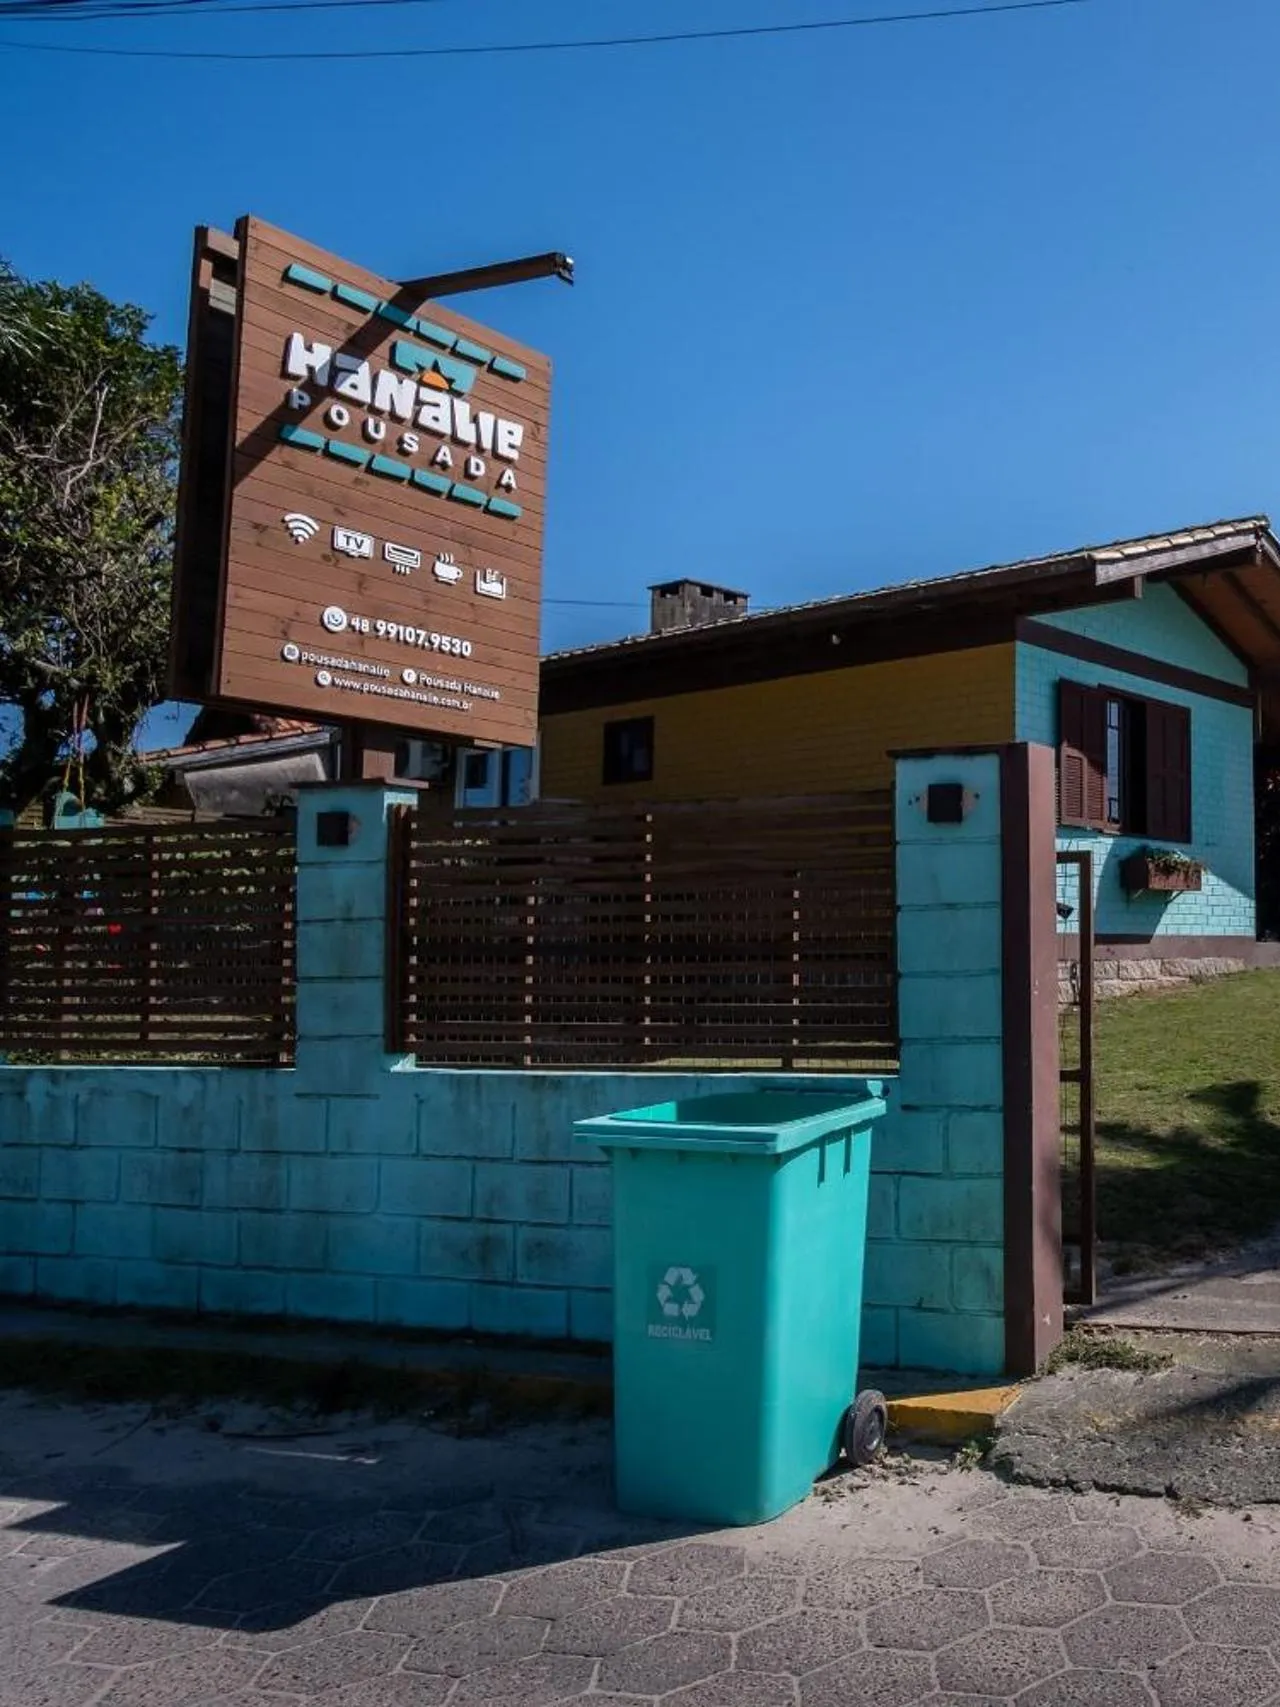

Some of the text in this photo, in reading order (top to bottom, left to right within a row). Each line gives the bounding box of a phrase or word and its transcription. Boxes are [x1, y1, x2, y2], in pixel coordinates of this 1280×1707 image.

[287, 386, 517, 491] POUSADA
[343, 534, 364, 549] TV
[351, 617, 472, 657] 48 99107.9530
[301, 651, 390, 678] pousadahanalie
[419, 673, 461, 692] Pousada
